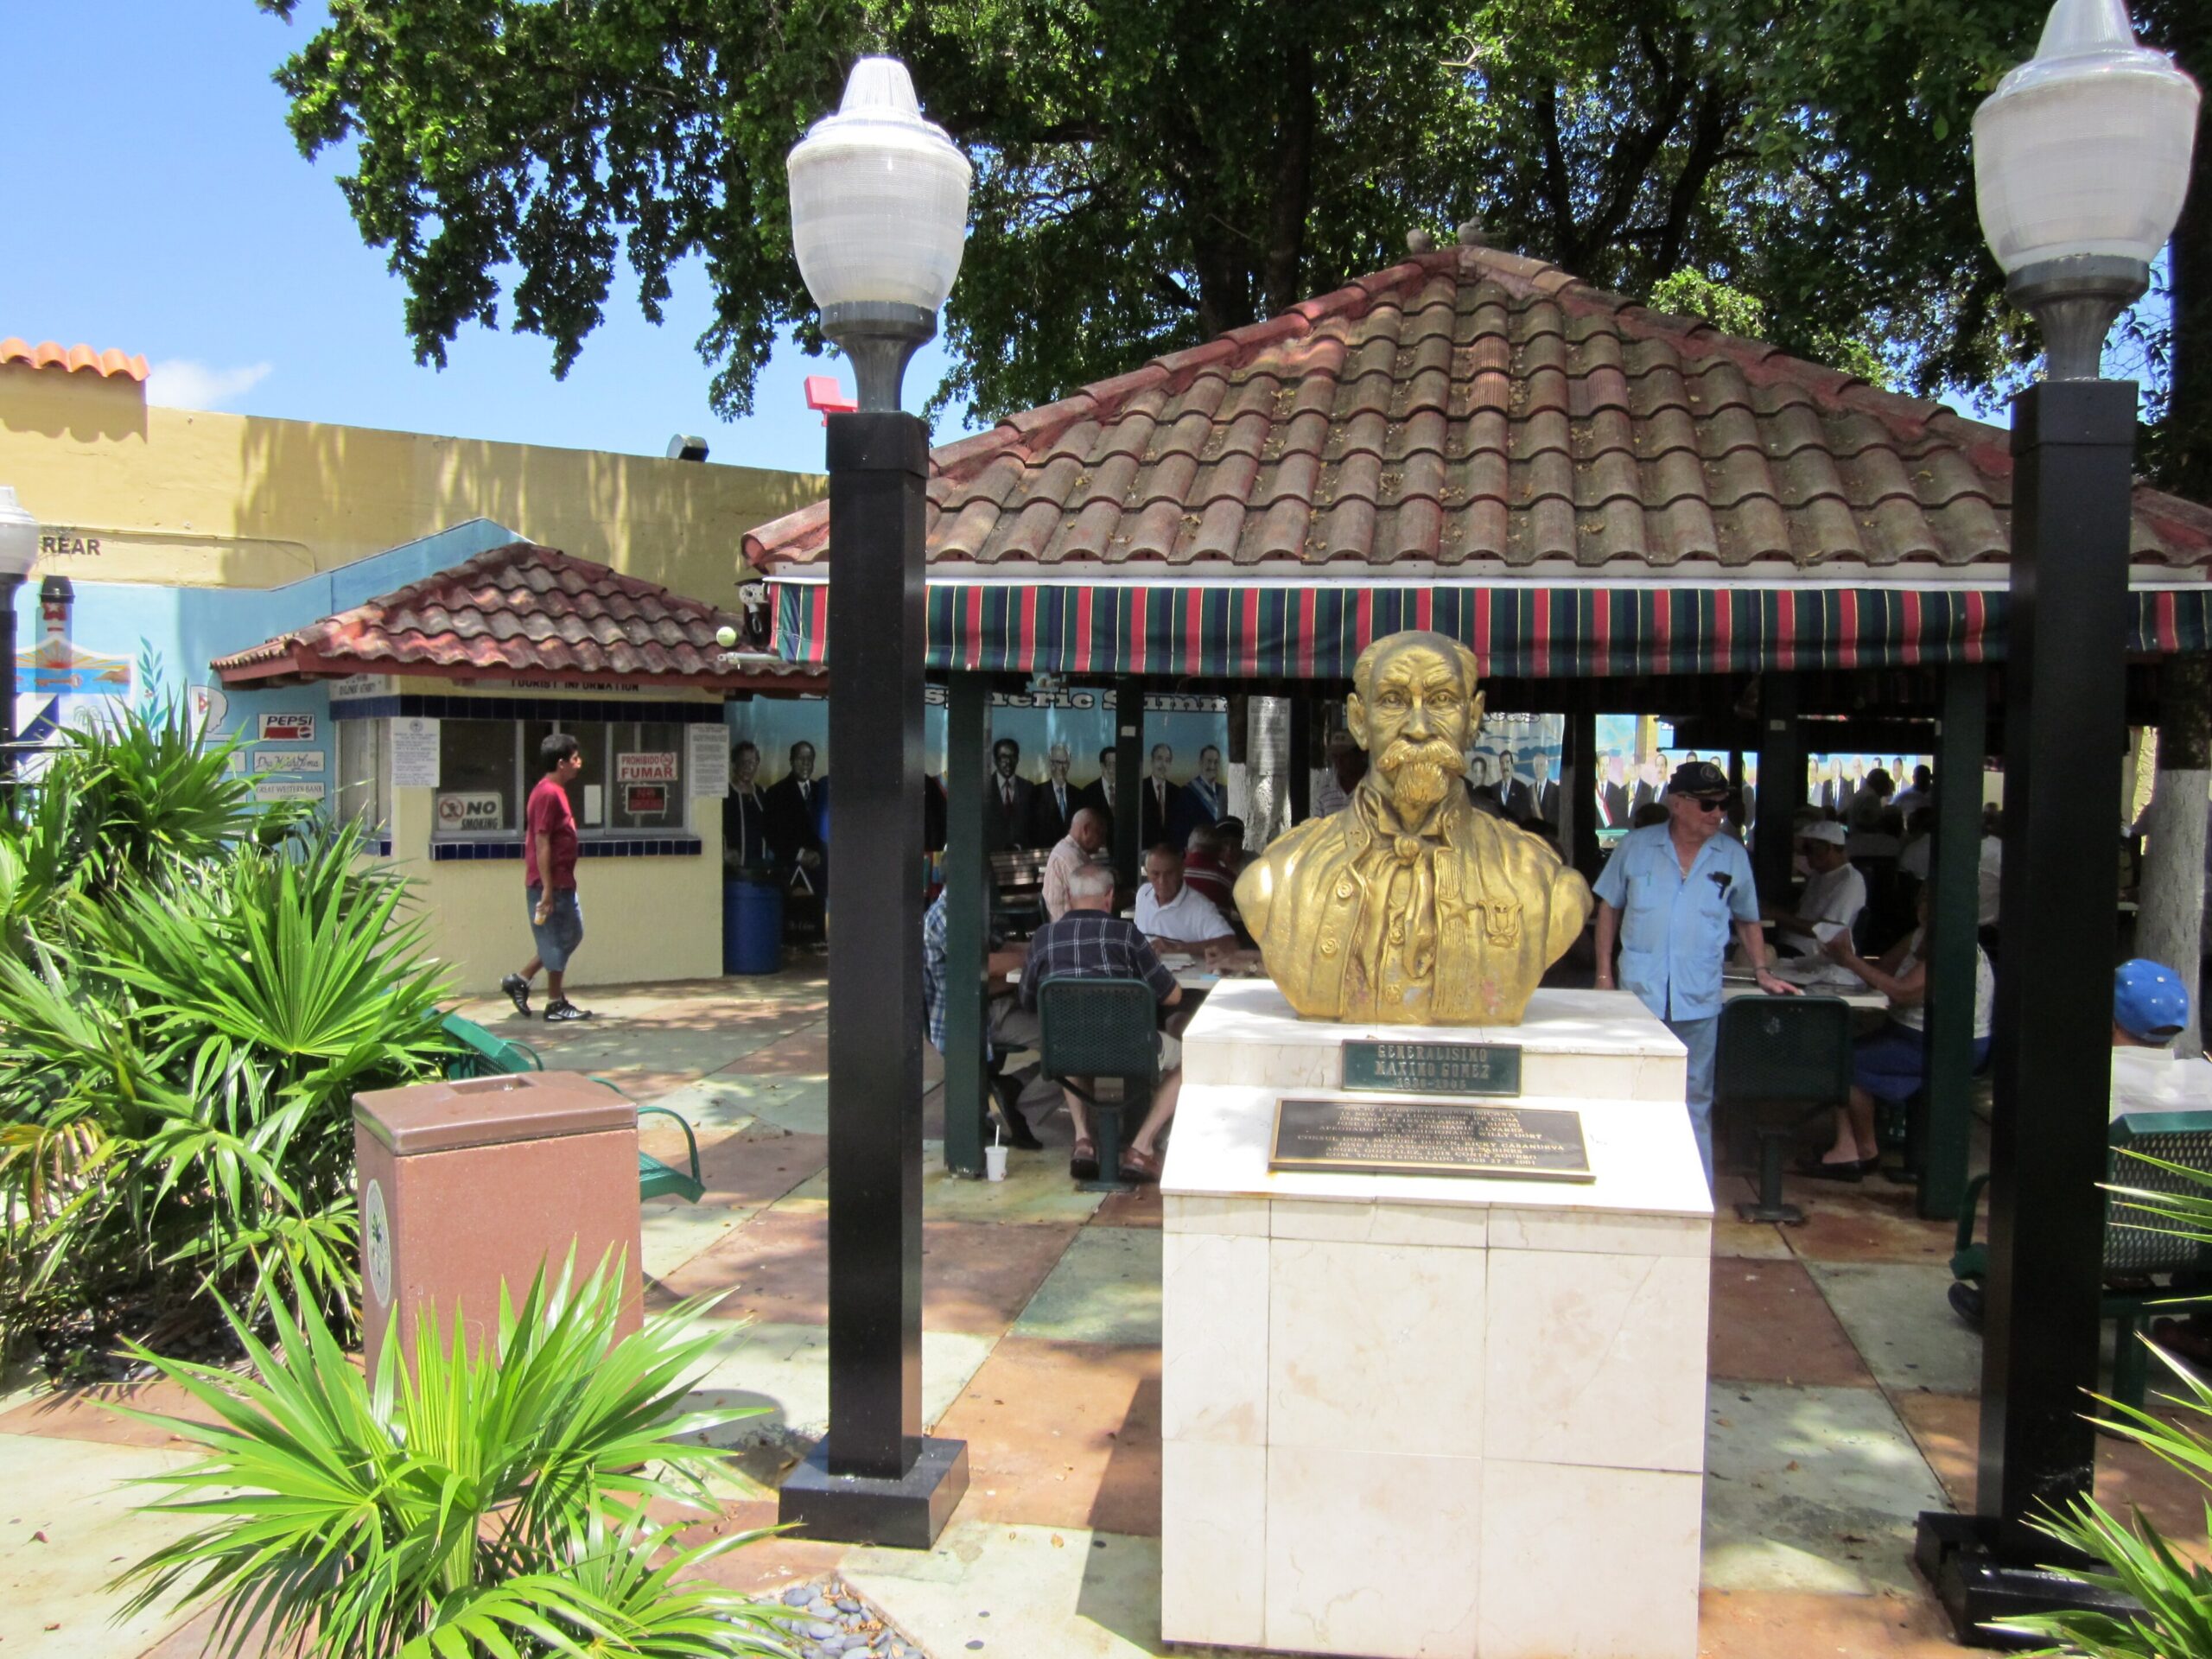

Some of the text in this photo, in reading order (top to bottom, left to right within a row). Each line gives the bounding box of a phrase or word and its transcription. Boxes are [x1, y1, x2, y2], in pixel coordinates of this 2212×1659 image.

[42, 536, 101, 556] REAR
[267, 715, 313, 726] PEPSI
[622, 755, 659, 766] PROHIBIDO
[621, 766, 673, 779] FUMAR
[256, 785, 275, 794] GREAT
[305, 785, 322, 793] BANK
[467, 801, 497, 815] NO
[461, 817, 499, 830] SMOKING
[1377, 1045, 1489, 1062] GENERALISIMO
[1375, 1061, 1491, 1079] MAXIMO GOMEZ
